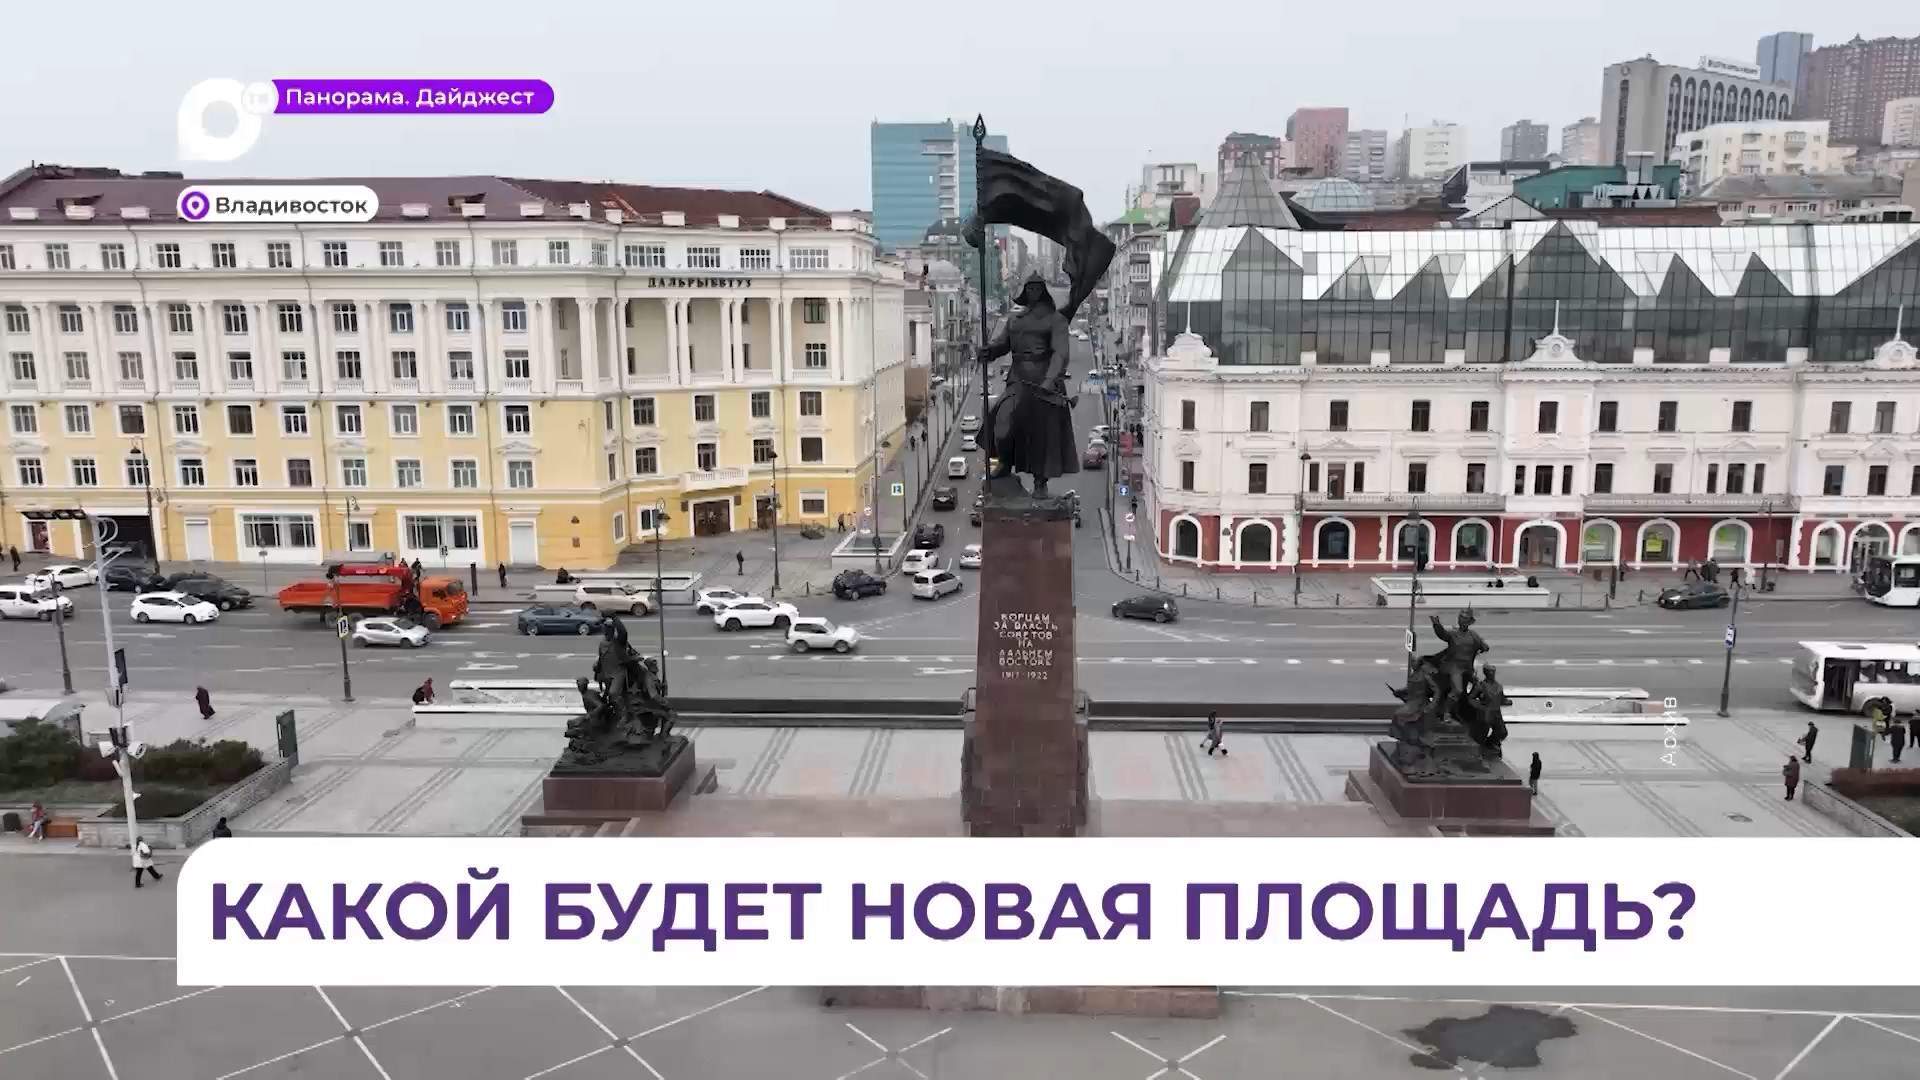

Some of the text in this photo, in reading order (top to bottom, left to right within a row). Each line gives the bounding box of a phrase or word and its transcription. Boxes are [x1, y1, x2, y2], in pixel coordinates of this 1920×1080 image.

[993, 621, 1058, 631] ЗА ВЛАСТЬ
[1000, 631, 1053, 640] СОВЕТОВ
[1018, 640, 1033, 648] НА
[999, 649, 1053, 658] ДАЛЬНЕМ
[999, 657, 1052, 666] ВОСТОКЕ
